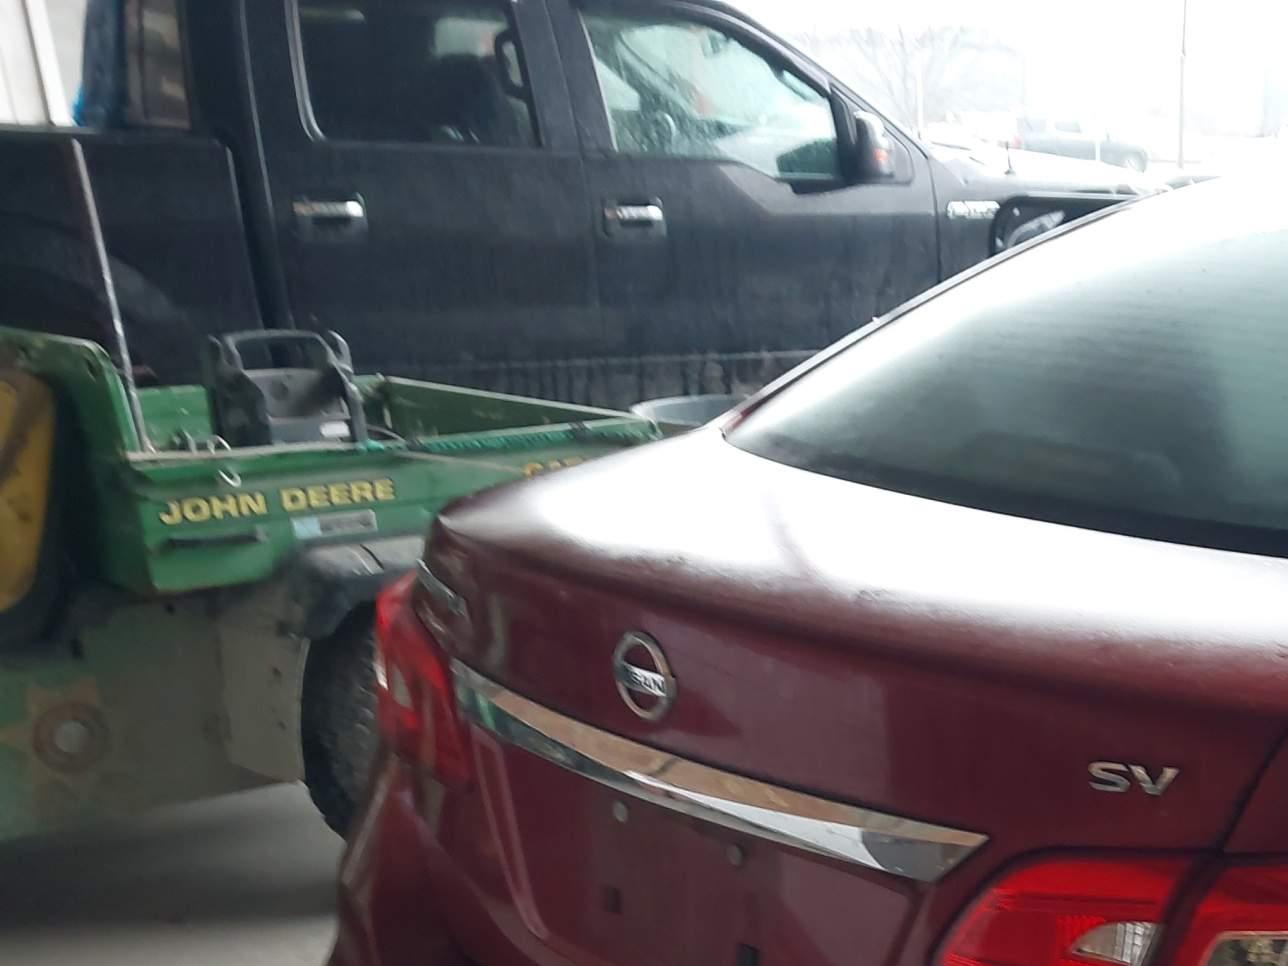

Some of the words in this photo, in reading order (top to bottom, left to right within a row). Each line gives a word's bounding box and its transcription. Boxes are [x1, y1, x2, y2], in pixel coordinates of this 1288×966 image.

[159, 492, 268, 525] JOHN
[279, 478, 395, 513] DEERE
[1087, 761, 1180, 796] SV
